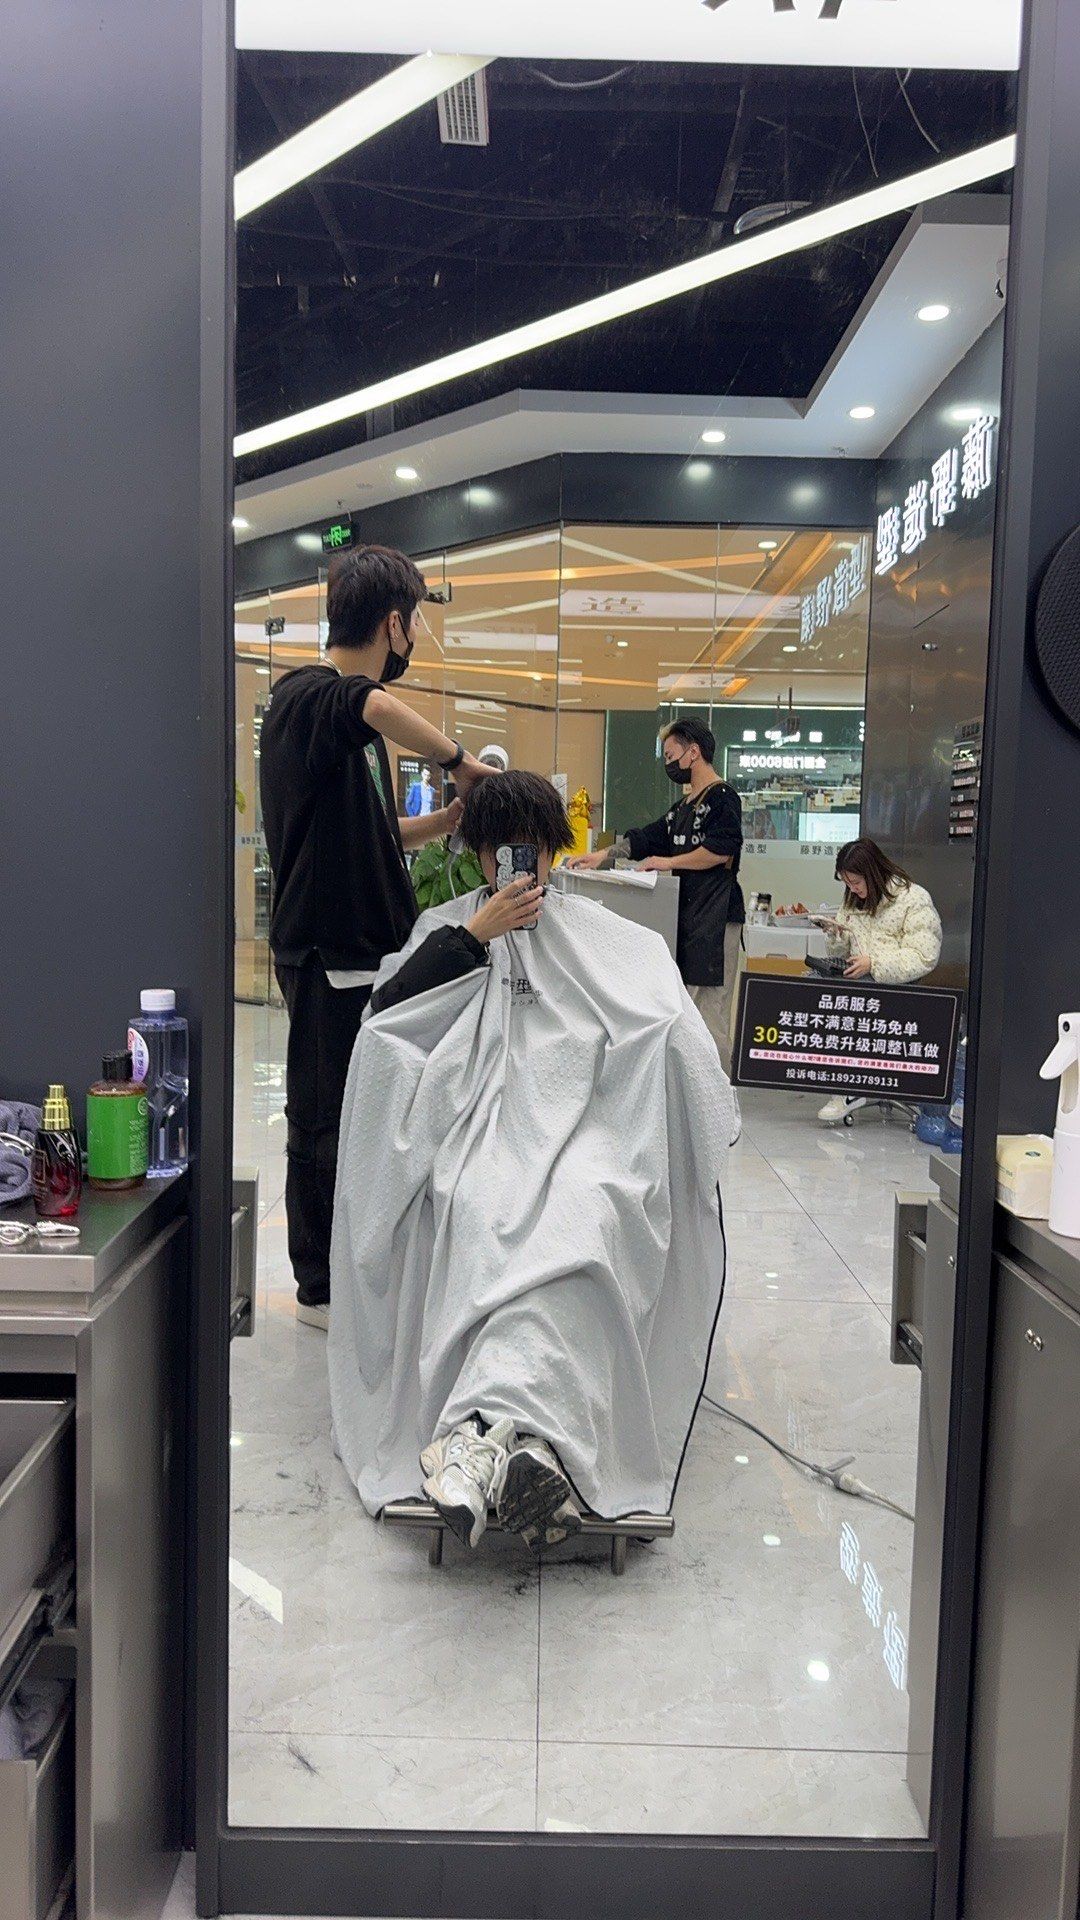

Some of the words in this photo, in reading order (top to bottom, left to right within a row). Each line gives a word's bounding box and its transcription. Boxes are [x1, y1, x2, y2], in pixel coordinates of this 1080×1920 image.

[818, 994, 881, 1013] 品质服务
[778, 1011, 918, 1037] 发型不满意当场免单
